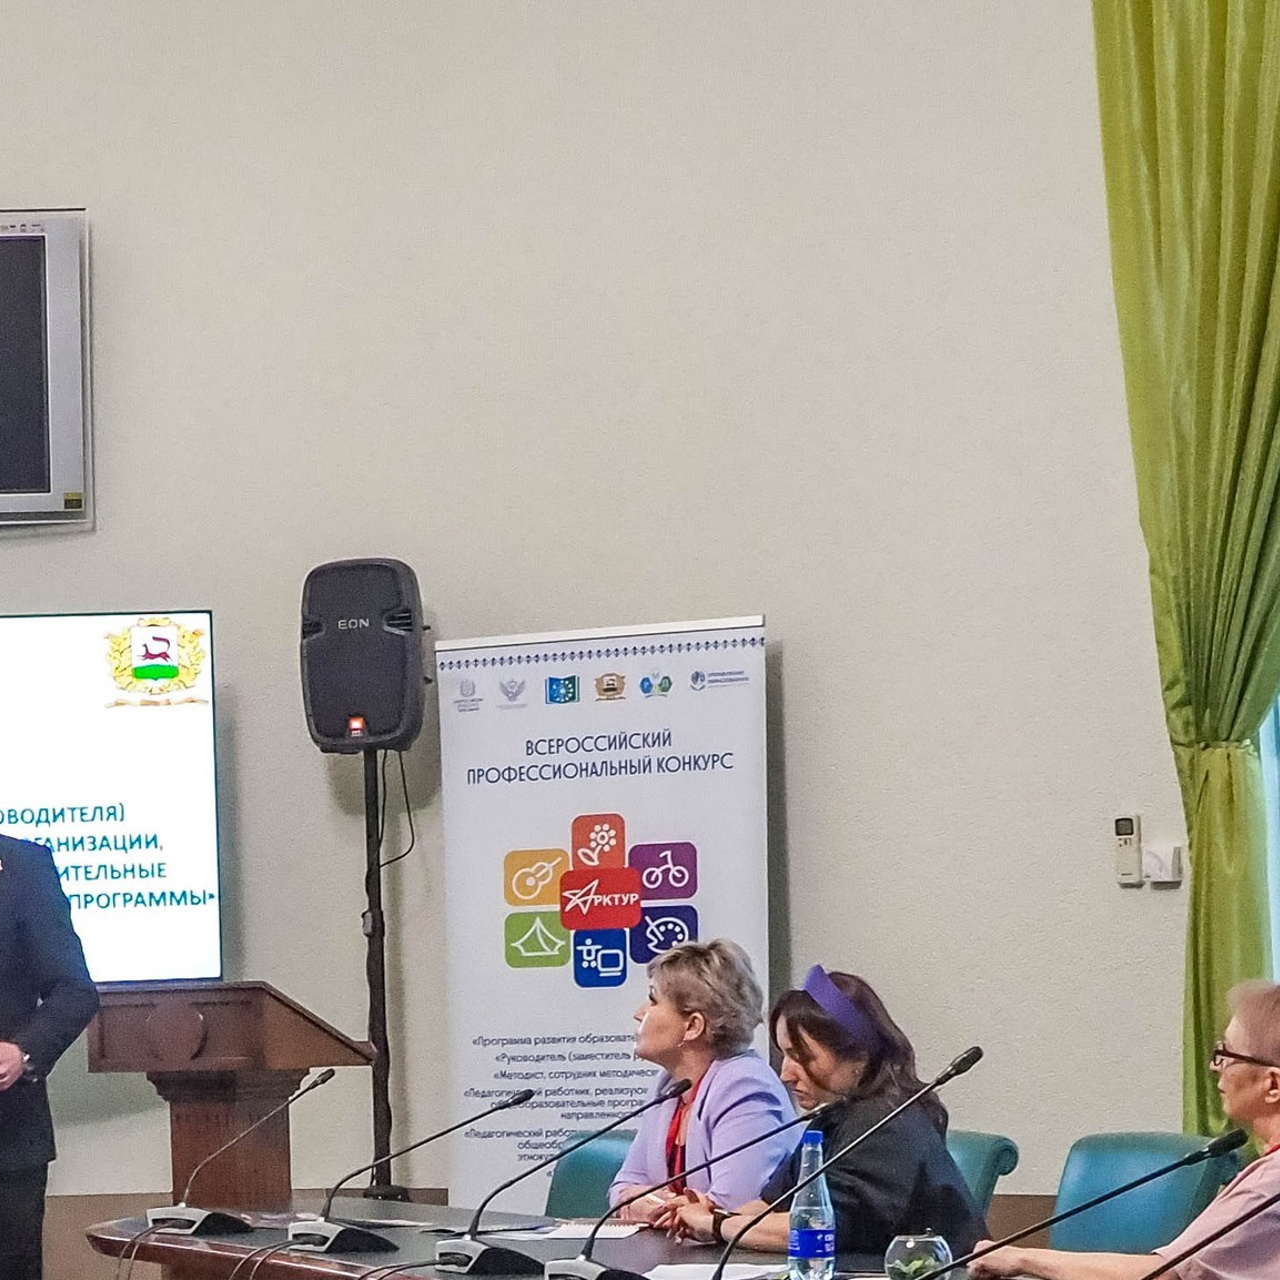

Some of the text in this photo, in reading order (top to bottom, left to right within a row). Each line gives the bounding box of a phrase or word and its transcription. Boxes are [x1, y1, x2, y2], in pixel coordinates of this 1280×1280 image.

[337, 618, 370, 630] EON
[525, 728, 673, 757] ВСЕРОССИЙСКИЙ
[466, 752, 734, 786] ПРОФЕССИОНАЛЬНЫЙ КОНКУРС
[68, 889, 216, 910] ПРОГРАММЫ»
